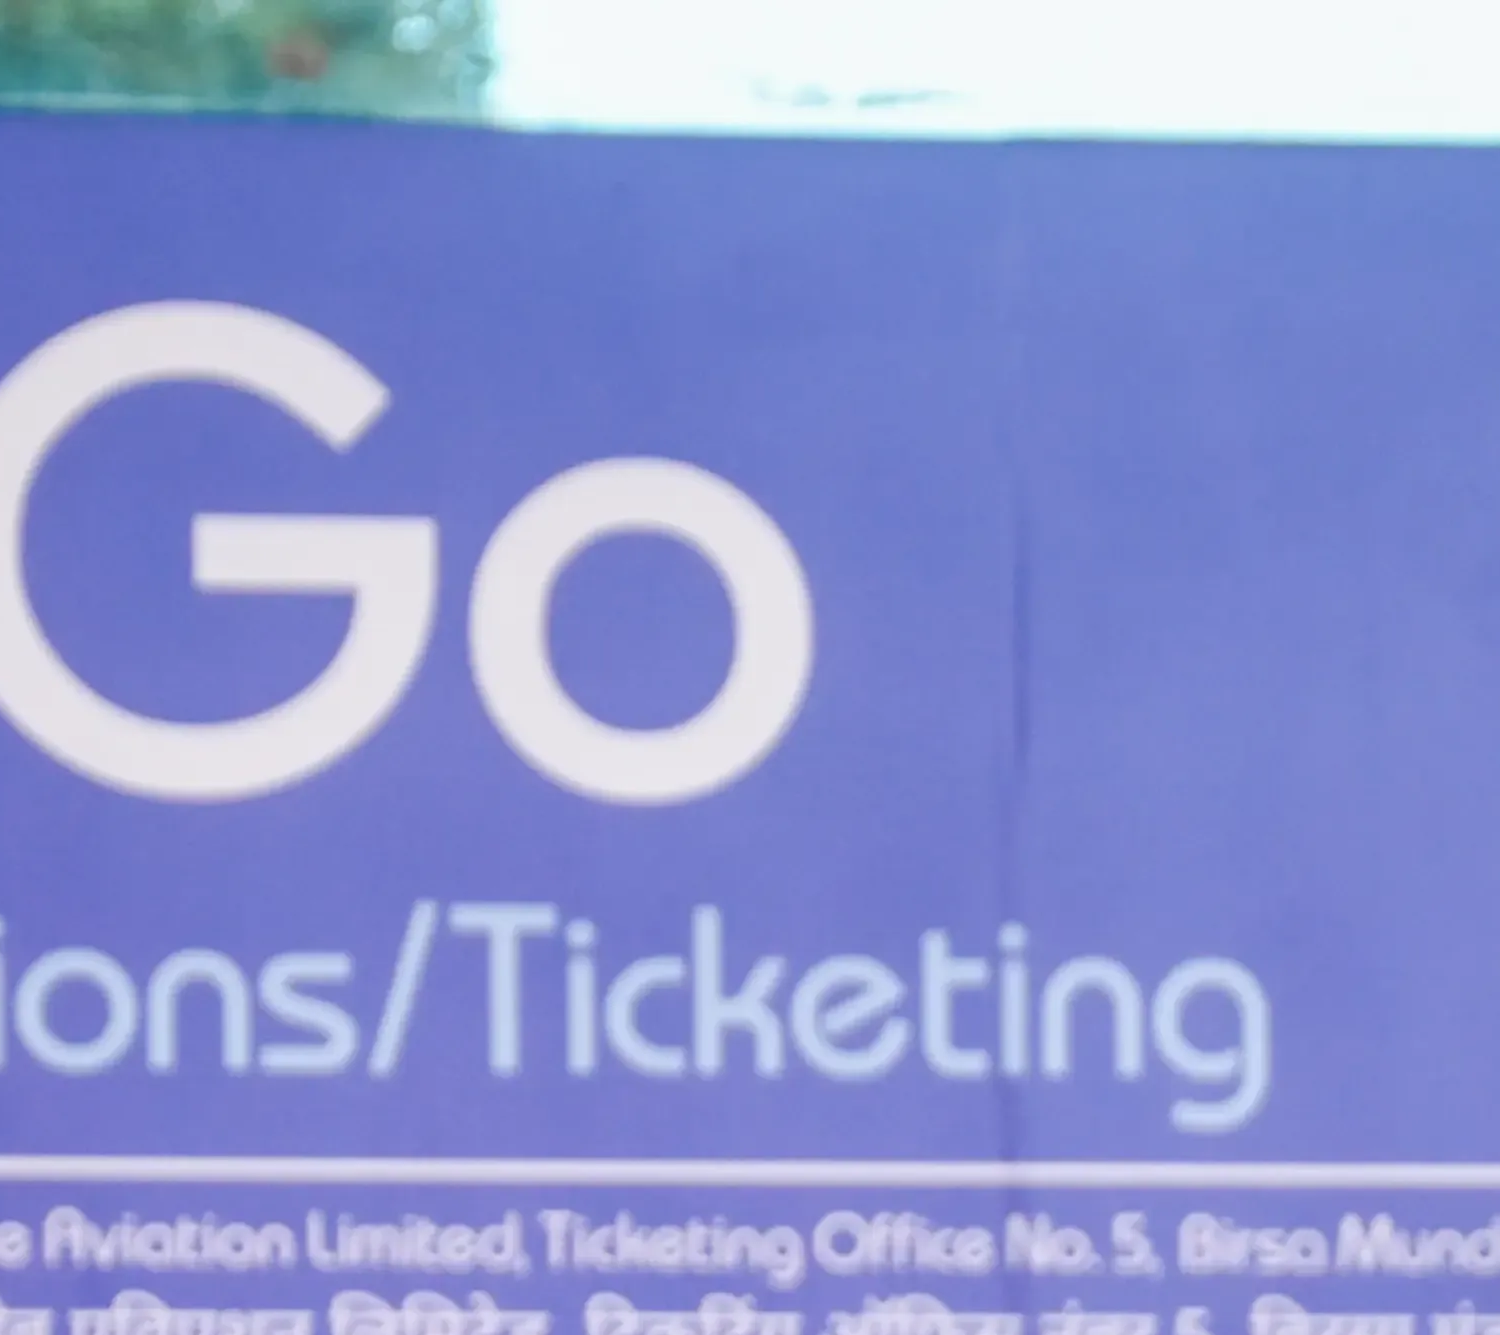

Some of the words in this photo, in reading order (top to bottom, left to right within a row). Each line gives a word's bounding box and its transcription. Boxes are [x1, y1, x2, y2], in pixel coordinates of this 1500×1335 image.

[42, 1204, 297, 1271] Aviation
[306, 1207, 531, 1274] Limited,
[538, 1209, 807, 1290] Ticketing
[813, 1210, 997, 1276] Office
[1005, 1211, 1104, 1275] No.
[1177, 1211, 1329, 1276] Birsa
